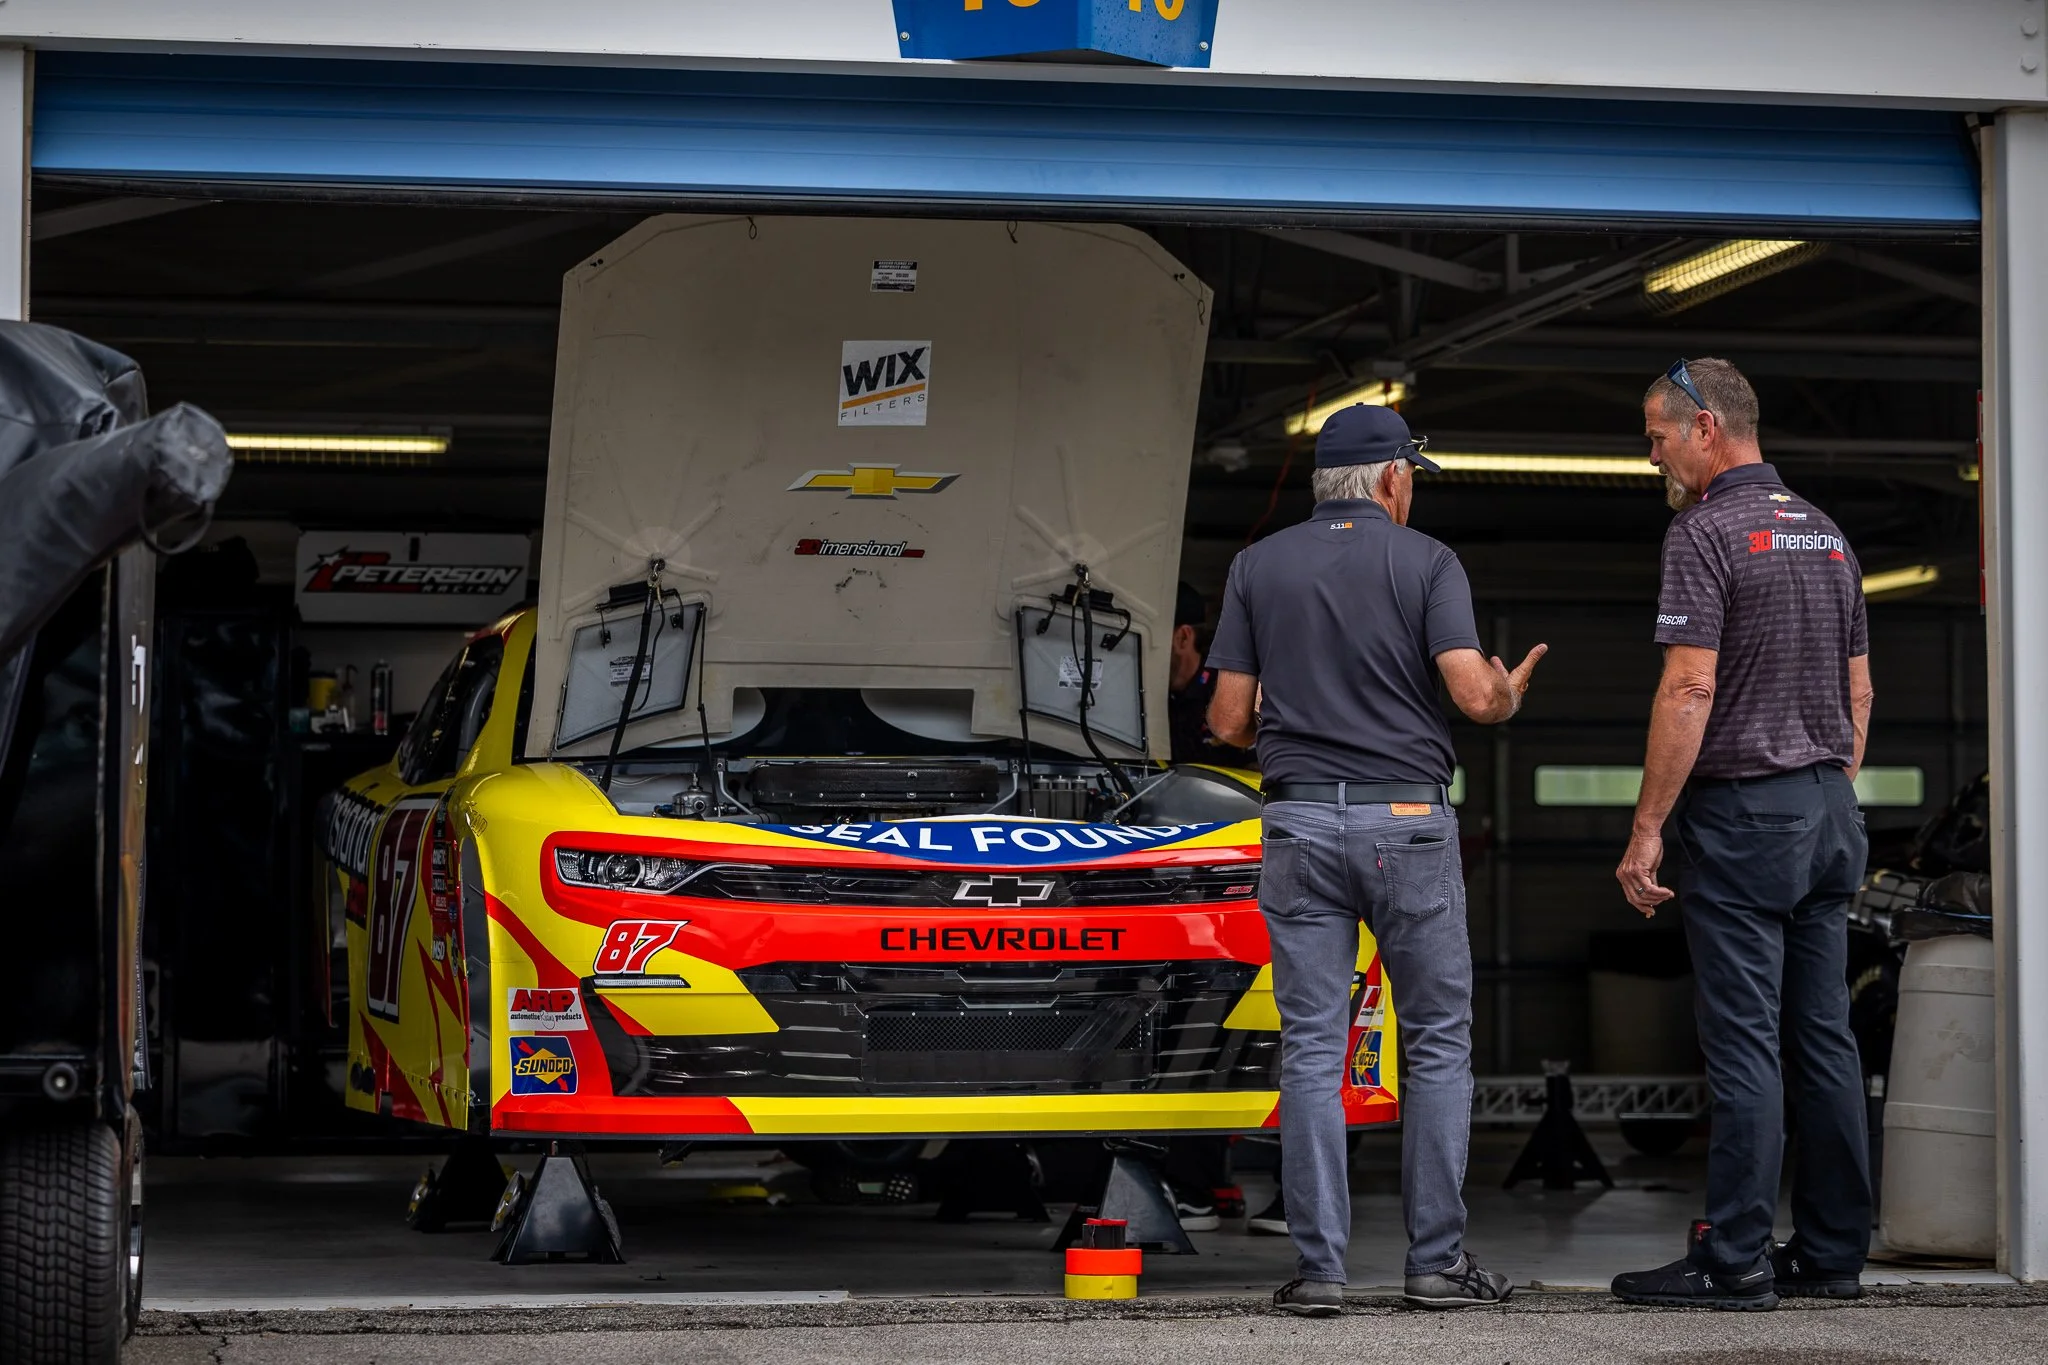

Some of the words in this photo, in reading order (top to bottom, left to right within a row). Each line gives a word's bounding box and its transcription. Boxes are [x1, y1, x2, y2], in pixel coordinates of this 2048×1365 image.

[842, 346, 926, 397] WIX
[840, 394, 926, 421] FILTERS
[331, 564, 519, 585] PETERSON
[421, 583, 507, 594] RACING
[366, 793, 444, 1024] 87
[592, 919, 692, 974] 87
[880, 927, 1127, 951] CHEVROLET
[511, 988, 576, 1013] ARP
[510, 1012, 541, 1021] automotive
[555, 1012, 582, 1022] products
[517, 1058, 571, 1074] SUNOCO
